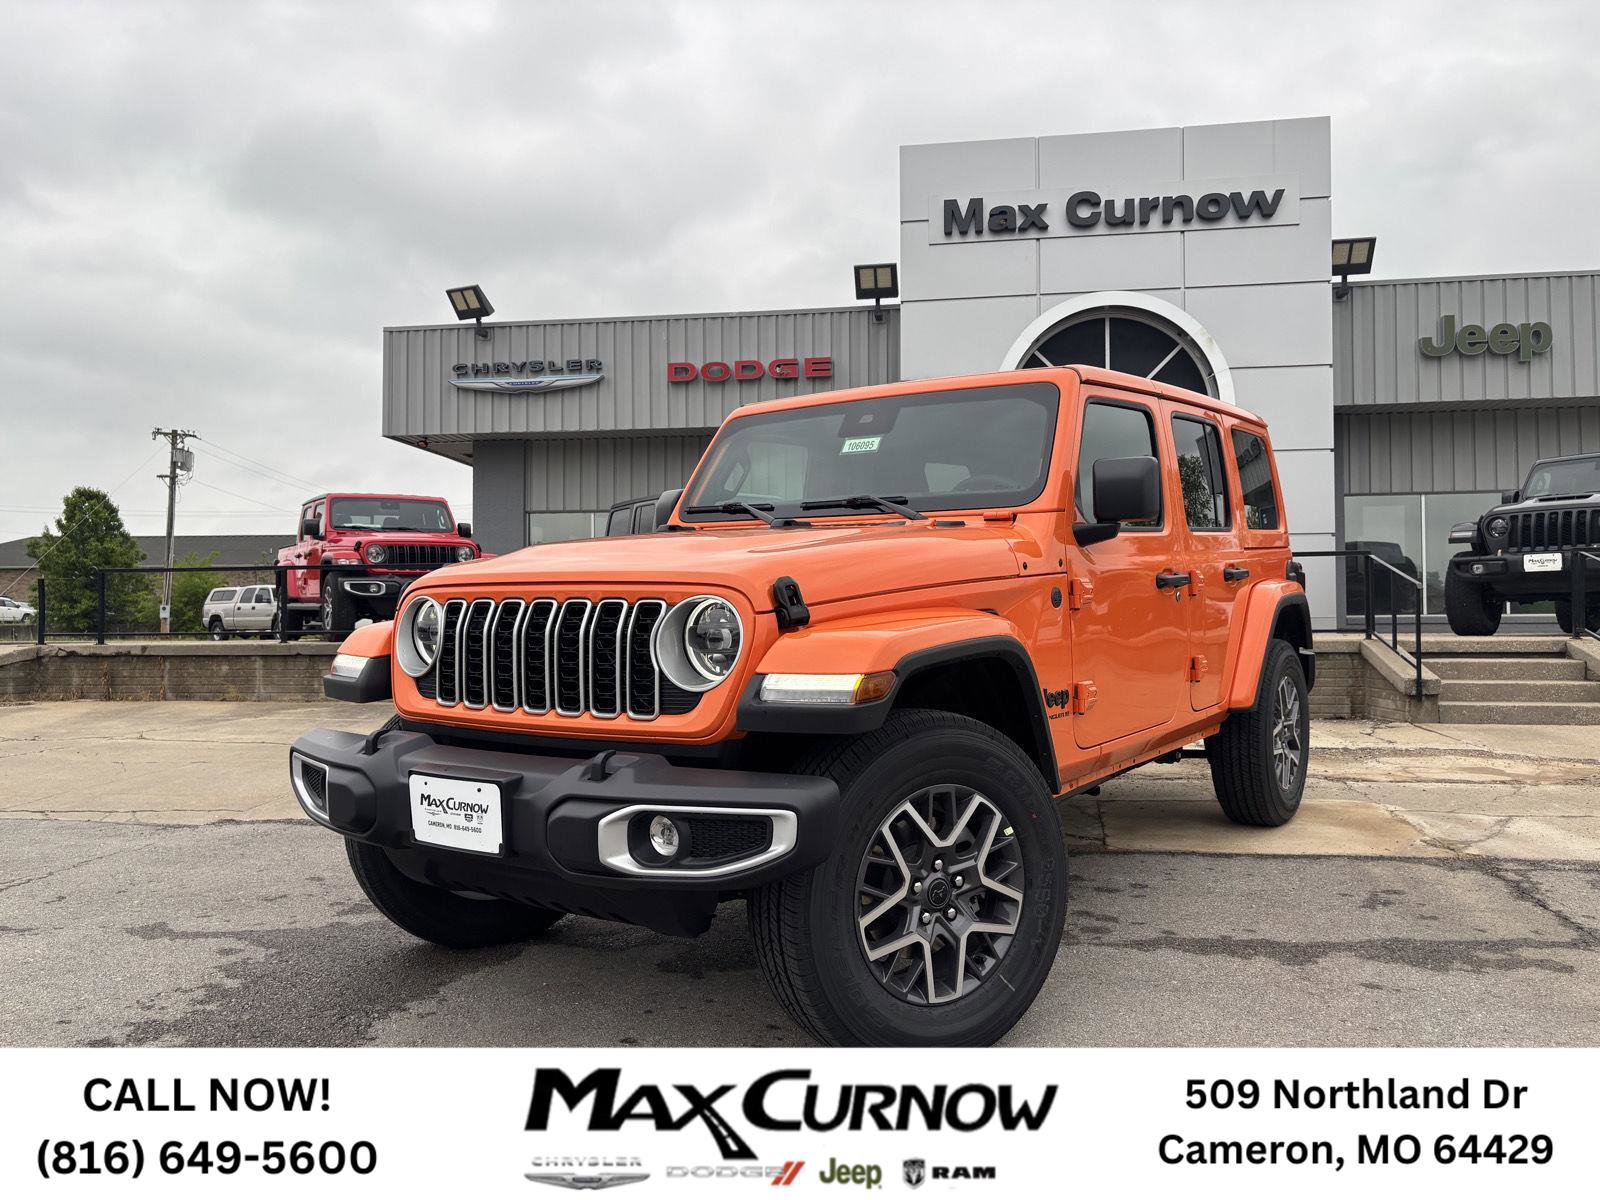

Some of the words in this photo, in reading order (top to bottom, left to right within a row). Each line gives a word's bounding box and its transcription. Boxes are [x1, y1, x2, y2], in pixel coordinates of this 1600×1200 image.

[943, 197, 1049, 236] Max
[1065, 189, 1285, 228] Curnow
[1418, 314, 1553, 363] Jeep
[452, 359, 603, 376] CHRYSLER
[667, 357, 833, 383] DODGE
[848, 441, 875, 450] 106095
